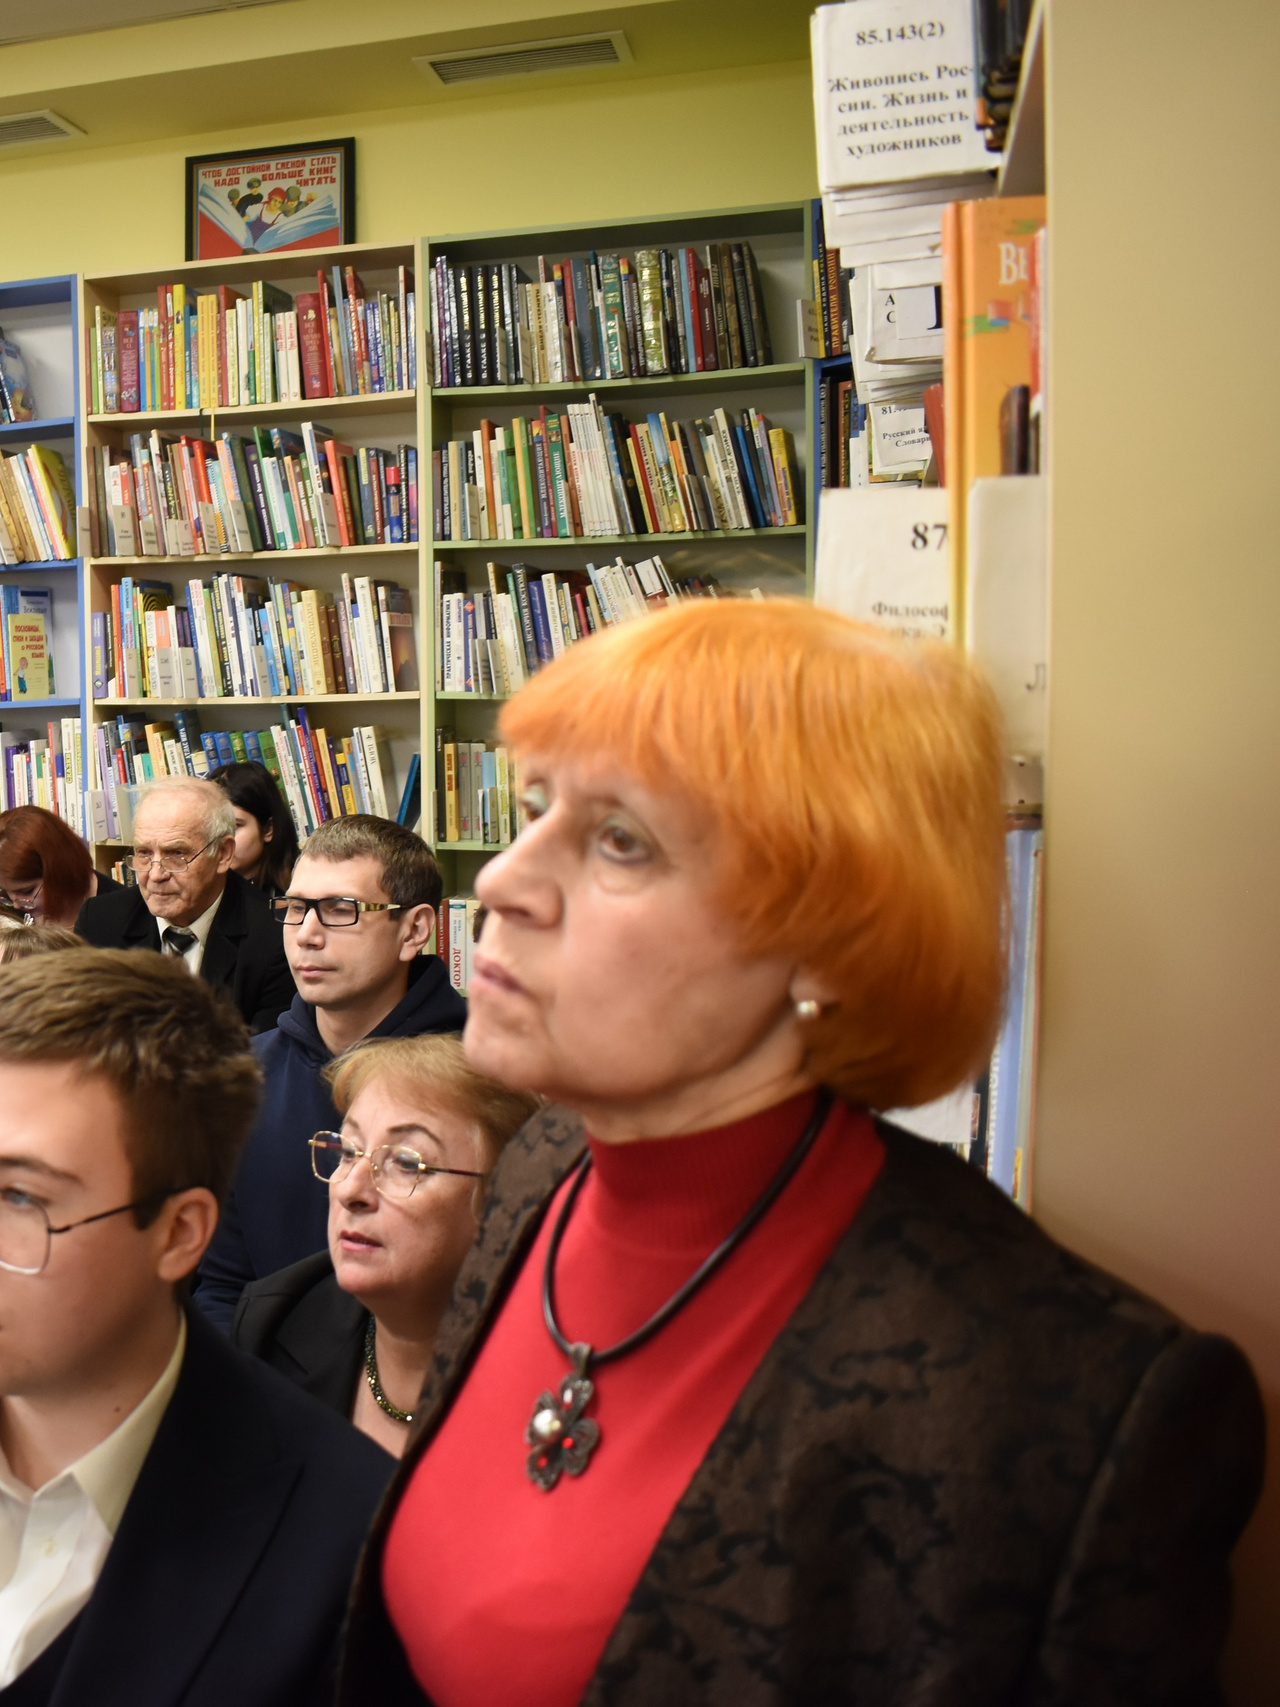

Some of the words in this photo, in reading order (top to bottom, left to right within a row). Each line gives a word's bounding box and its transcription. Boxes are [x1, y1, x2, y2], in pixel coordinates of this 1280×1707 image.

[856, 21, 945, 46] 85.143(2)
[828, 70, 929, 92] Живопись
[936, 64, 973, 79] Рос-
[837, 99, 877, 114] сии.
[883, 92, 949, 108] Жизнь
[956, 89, 968, 99] и
[837, 111, 970, 137] деятельность
[846, 134, 962, 159] художников
[202, 169, 222, 179] ЧТОБ
[226, 162, 271, 177] ДОСТОЙНОЙ
[275, 159, 306, 170] СМЕНОЙ
[310, 156, 337, 166] СТАТЬ
[214, 177, 240, 187] НАДО
[261, 169, 304, 182] БОЛЬШЕ
[309, 166, 336, 176] КНИГ
[296, 176, 337, 187] ЧИТАТЬ
[827, 252, 837, 290] РОССИИ
[830, 295, 840, 348] ПРАВИТЕЛИ
[882, 428, 916, 440] Русский
[911, 523, 948, 550] 87
[515, 568, 527, 606] КОСТЮМА
[522, 607, 534, 642] ИСТОРИЯ
[452, 947, 461, 987] ДОКТОР
